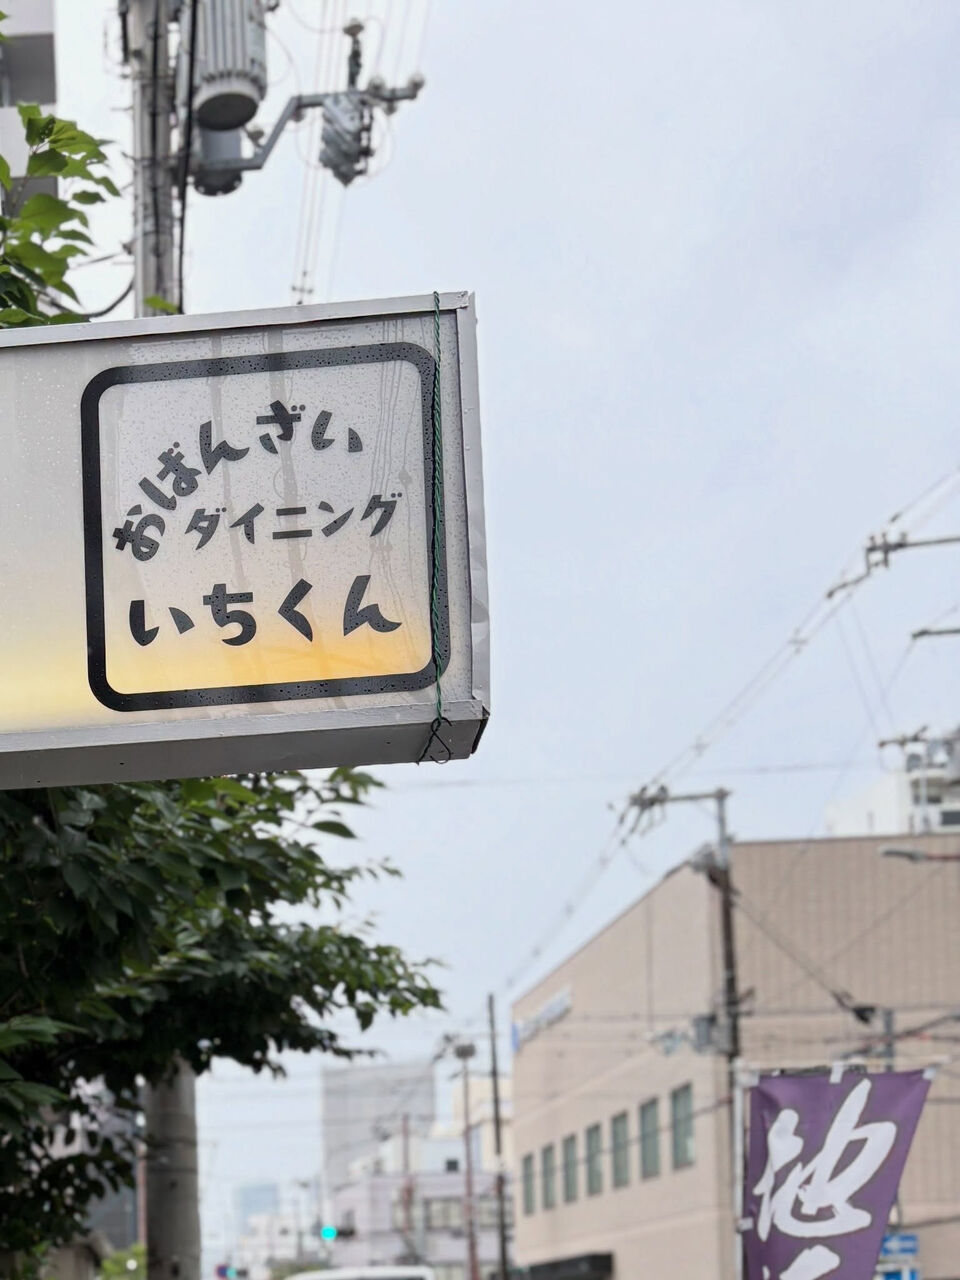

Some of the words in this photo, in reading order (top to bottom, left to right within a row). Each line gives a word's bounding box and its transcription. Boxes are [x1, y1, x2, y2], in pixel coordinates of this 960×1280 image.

[112, 399, 363, 562] おばんざい
[184, 492, 403, 551] ダイニング
[128, 574, 403, 647] いちくん
